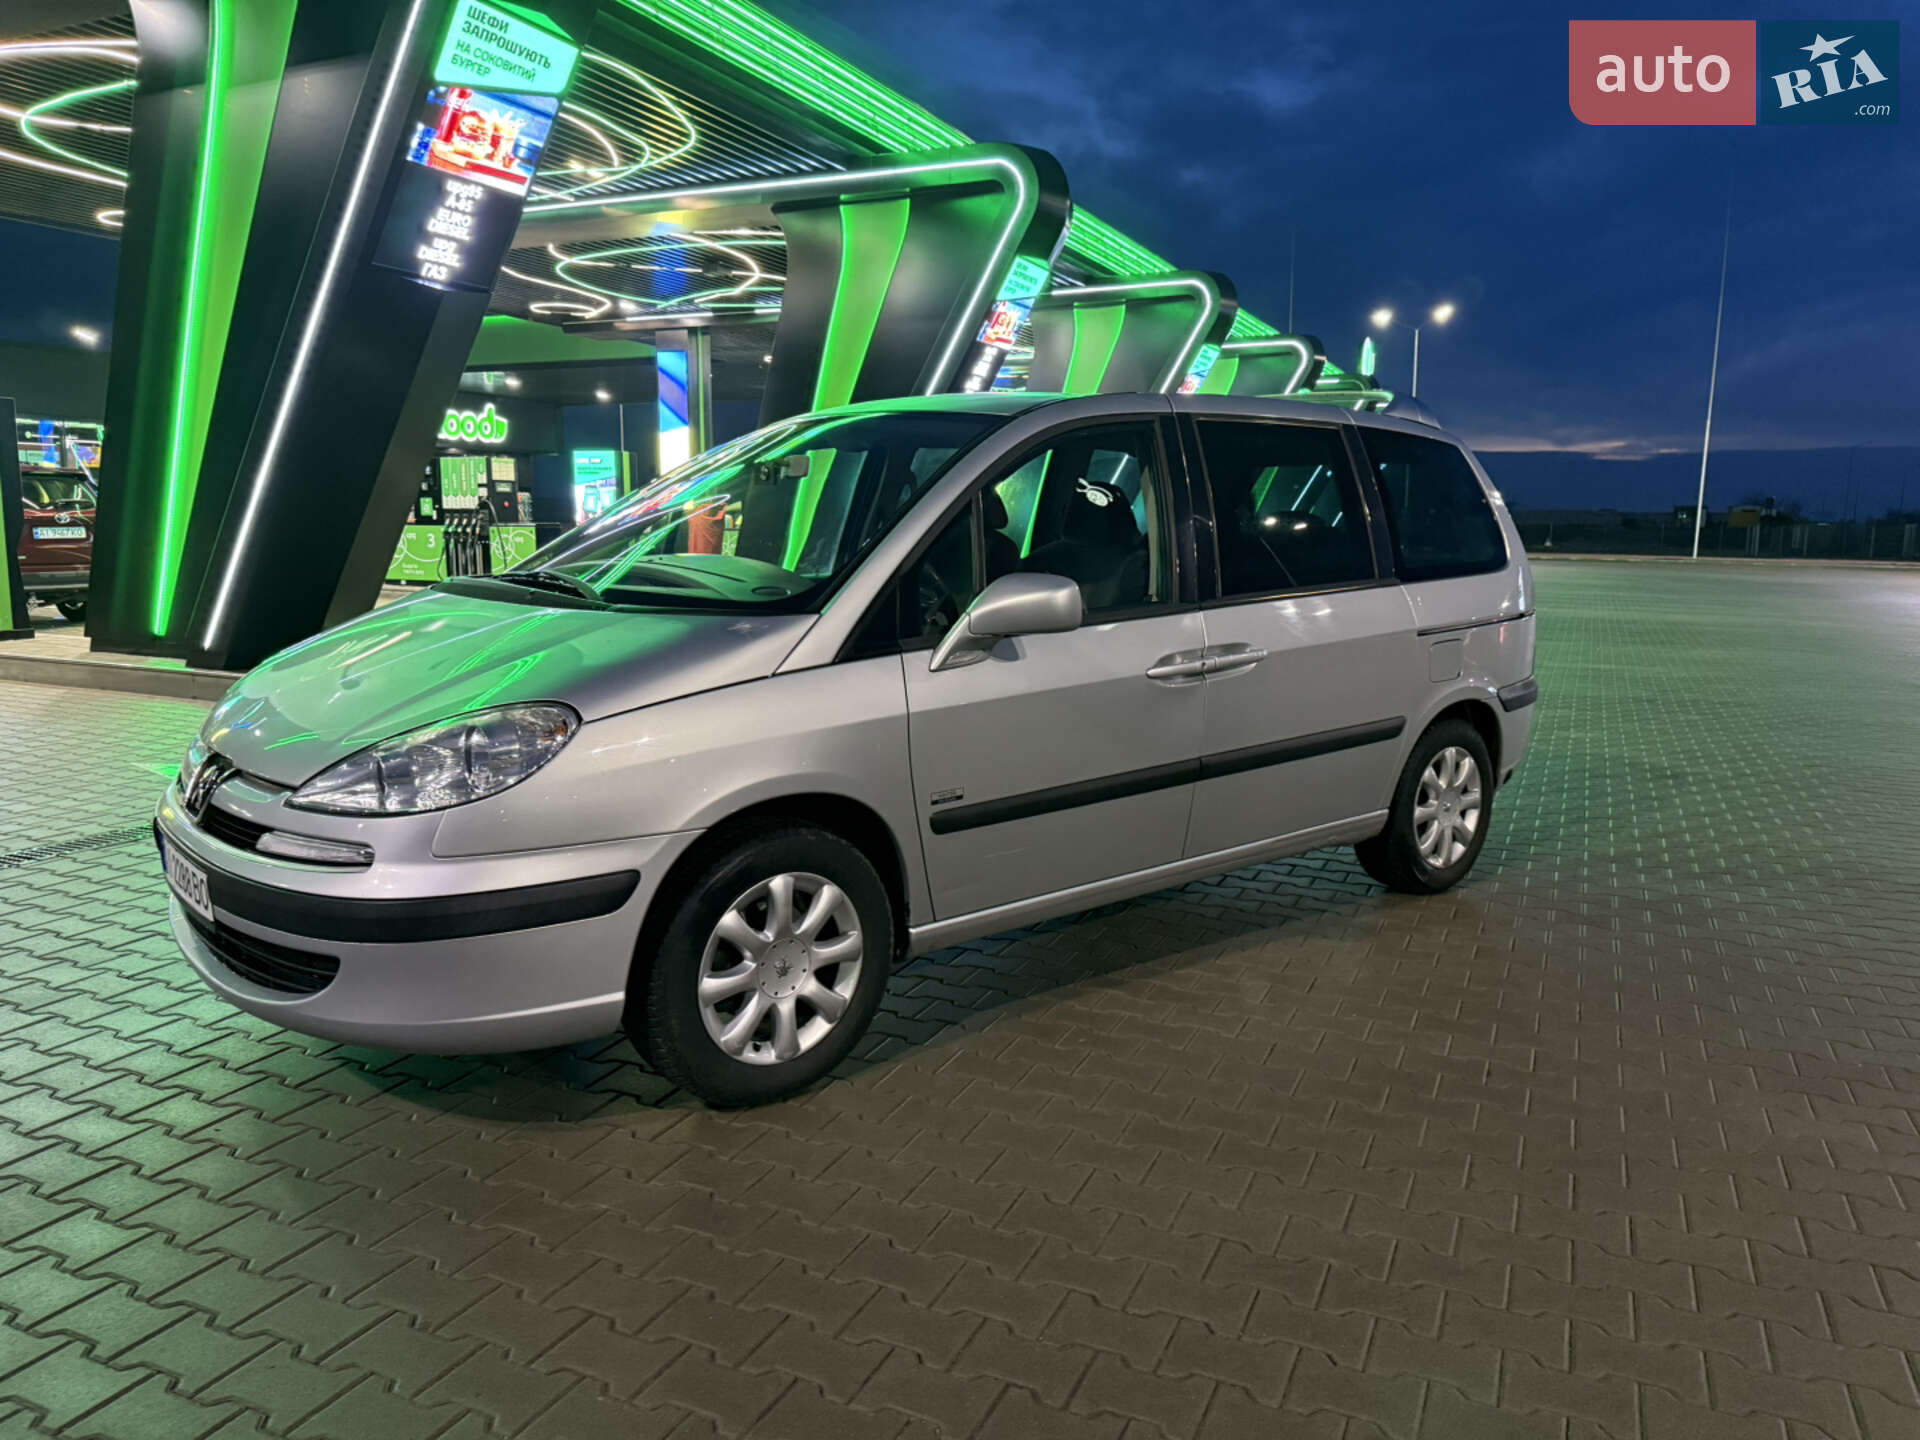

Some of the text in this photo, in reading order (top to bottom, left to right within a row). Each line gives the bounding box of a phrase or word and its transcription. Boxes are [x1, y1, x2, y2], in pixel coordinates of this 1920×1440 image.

[467, 5, 510, 34] ШЕФИ
[455, 39, 537, 82] НА СОКОВИТИЙ
[462, 20, 552, 69] ЗАПРОШУЮТЬ
[450, 53, 492, 78] БУРГЕР
[437, 402, 497, 443] ood
[426, 532, 436, 548] 3
